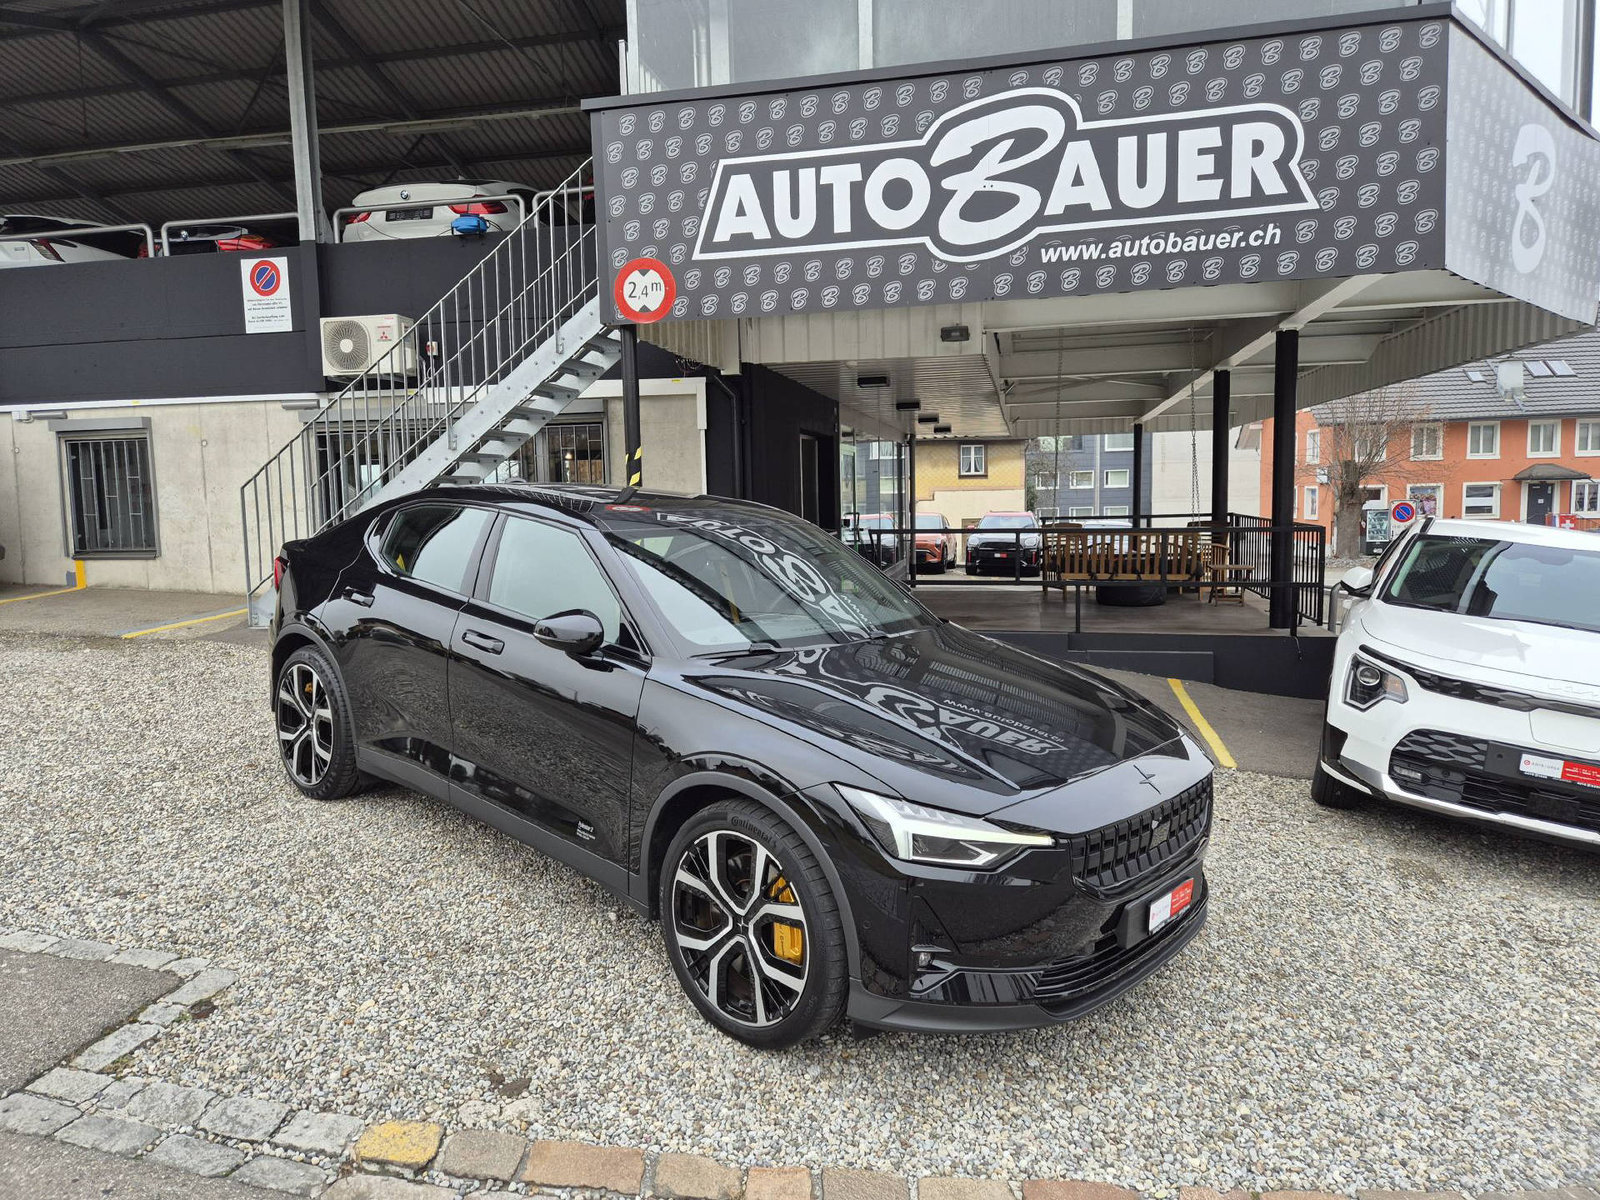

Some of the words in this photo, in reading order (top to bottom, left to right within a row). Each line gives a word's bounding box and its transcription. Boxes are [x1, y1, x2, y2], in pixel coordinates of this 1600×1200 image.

[929, 80, 948, 102] B
[962, 77, 982, 99] B
[1299, 98, 1320, 122] B
[1041, 223, 1281, 263] www.autobauer.ch
